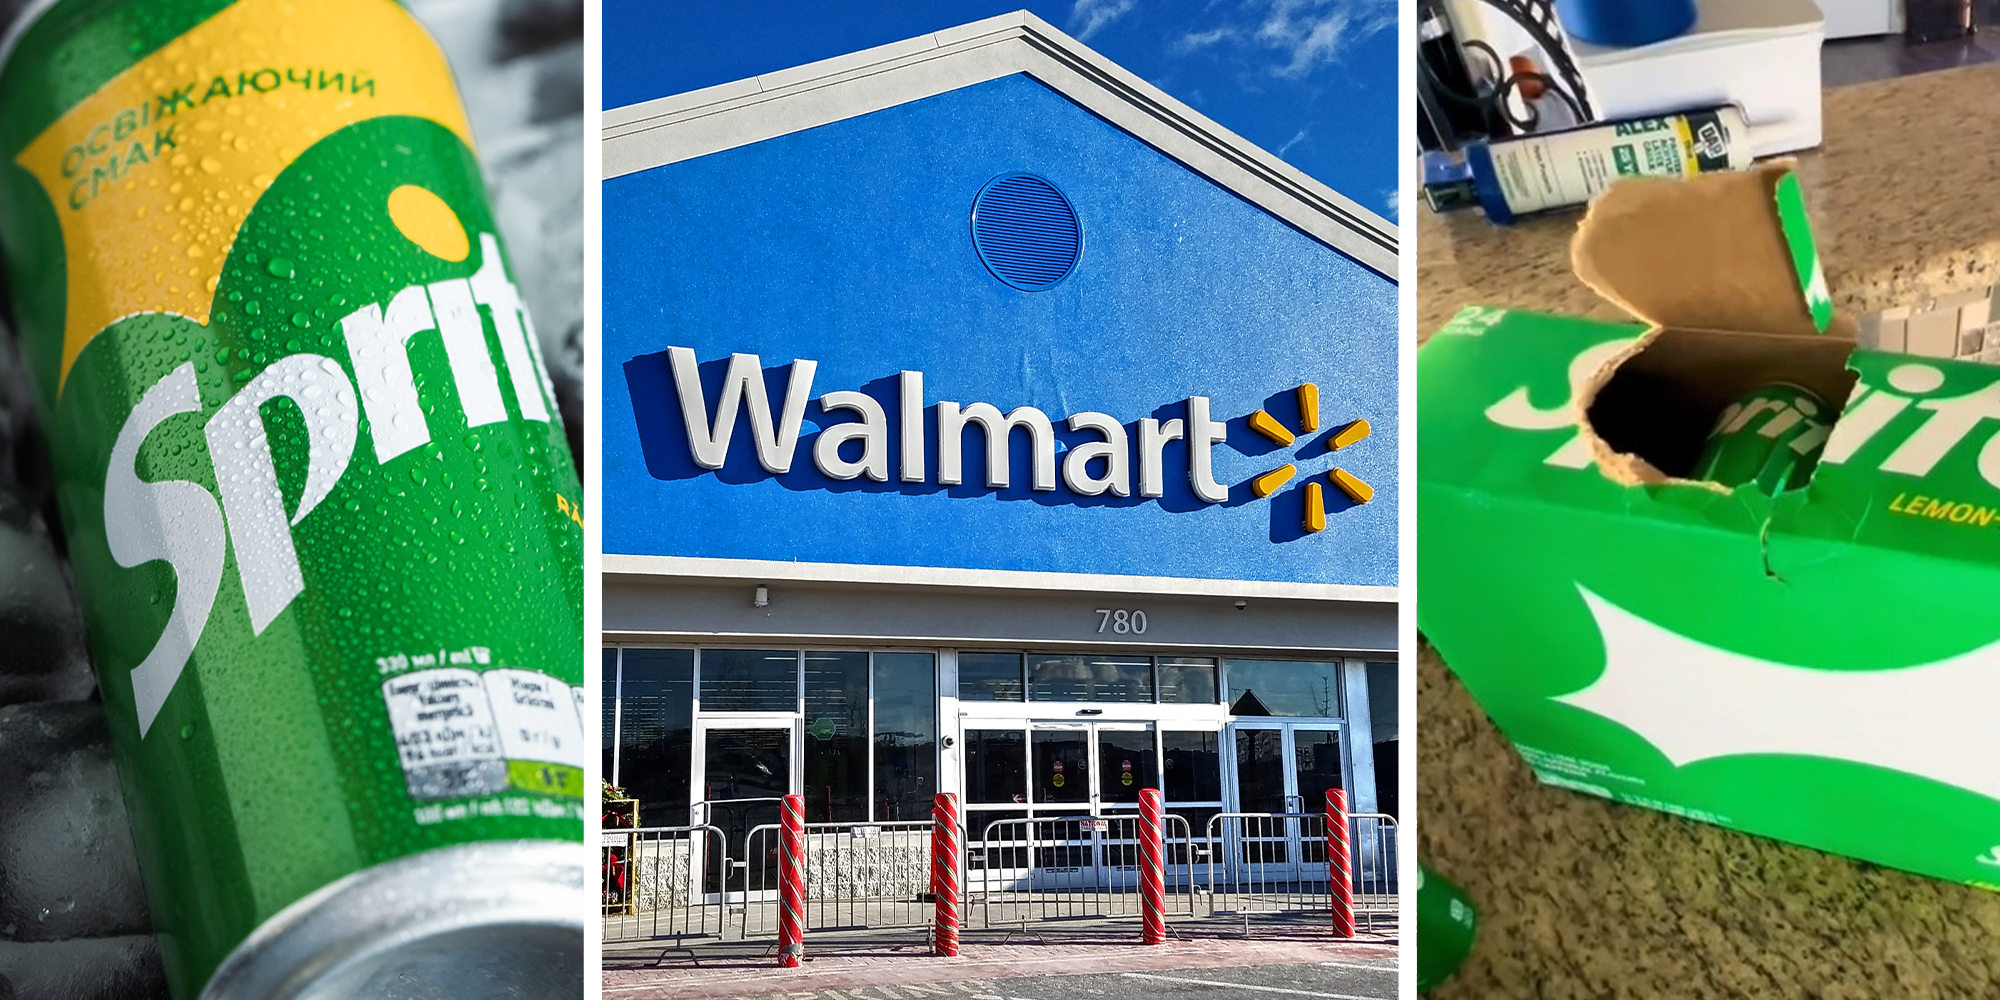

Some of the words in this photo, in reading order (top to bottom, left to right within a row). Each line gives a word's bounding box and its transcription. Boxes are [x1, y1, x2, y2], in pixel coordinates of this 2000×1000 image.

[61, 68, 377, 178] ОСВІЖАЮЧИЙ
[69, 123, 177, 211] СМАК
[1614, 117, 1670, 137] ALEX
[1452, 305, 1507, 327] 24
[104, 185, 562, 741] Sprit
[667, 346, 1229, 503] Walmart
[1095, 609, 1147, 635] 780
